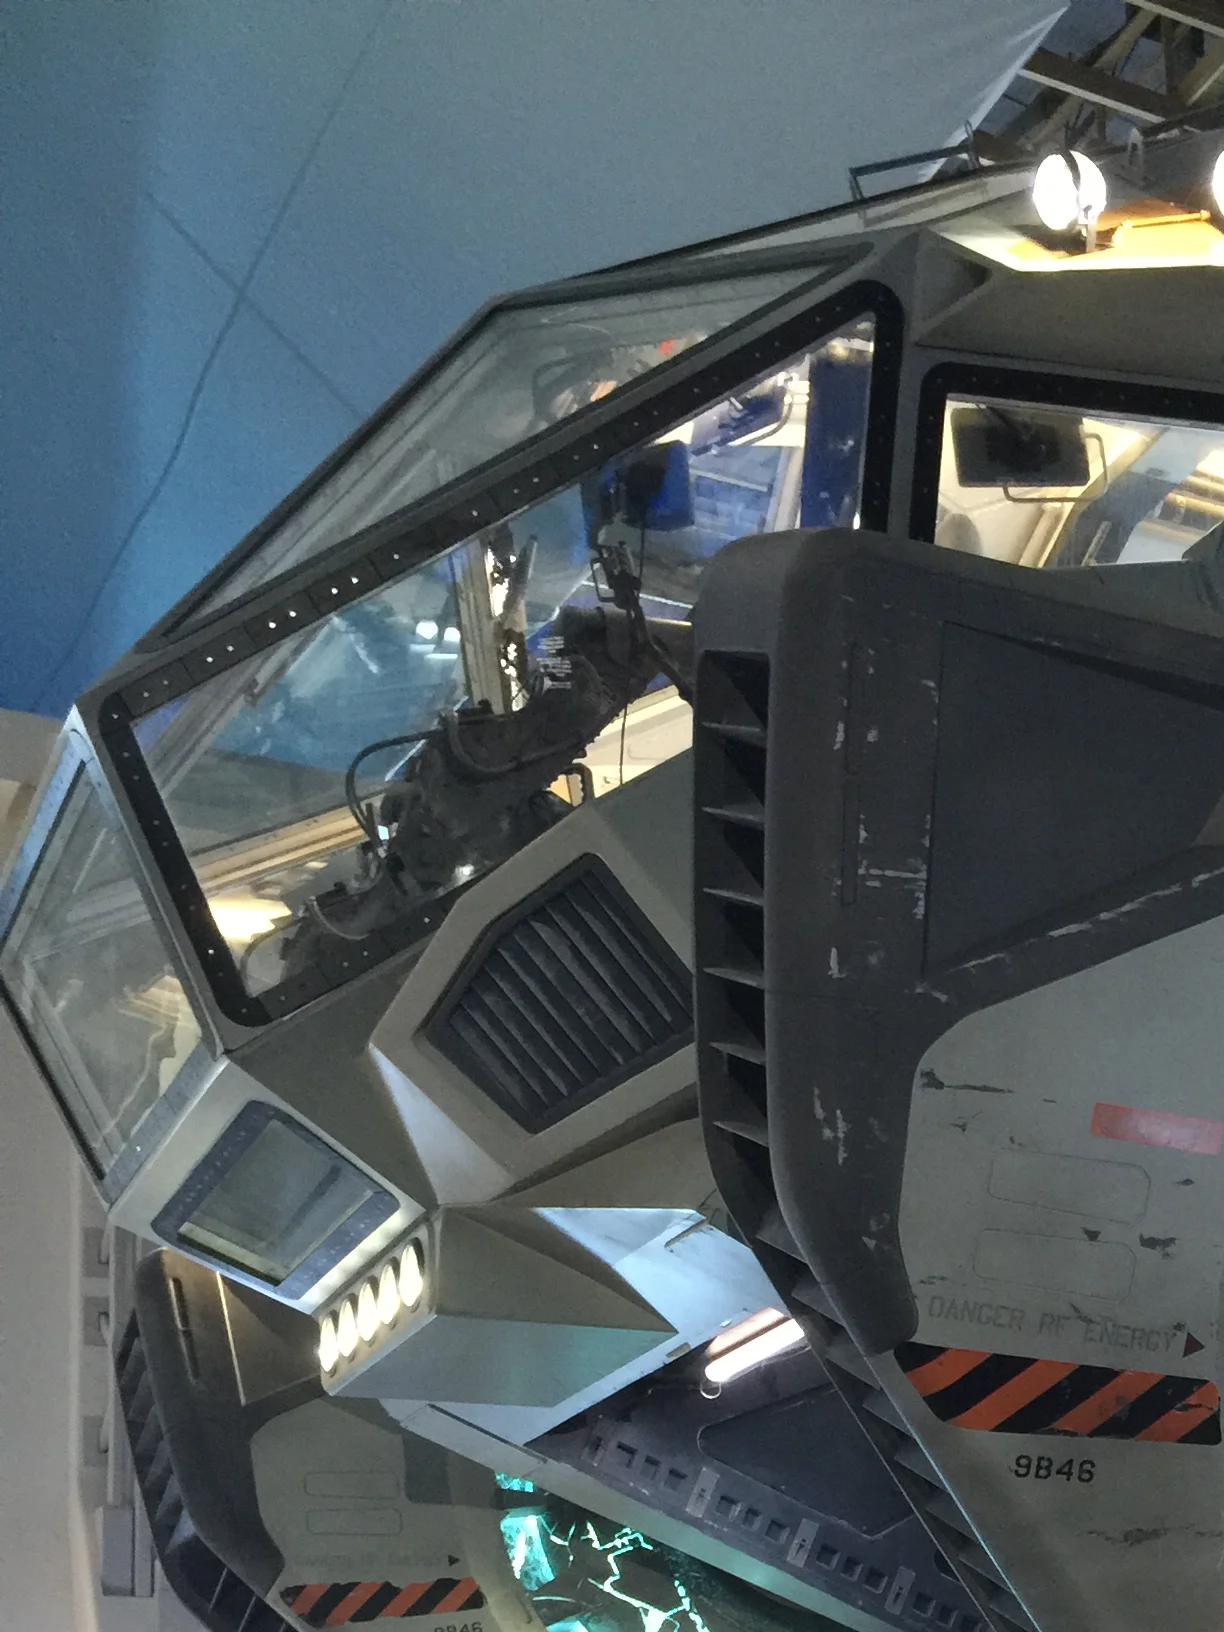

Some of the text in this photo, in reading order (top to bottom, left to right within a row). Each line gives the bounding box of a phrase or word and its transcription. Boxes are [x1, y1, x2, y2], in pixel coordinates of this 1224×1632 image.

[927, 1295, 1026, 1332] DANGER
[1083, 1314, 1177, 1352] ENERGY
[1014, 1454, 1096, 1483] 9B46
